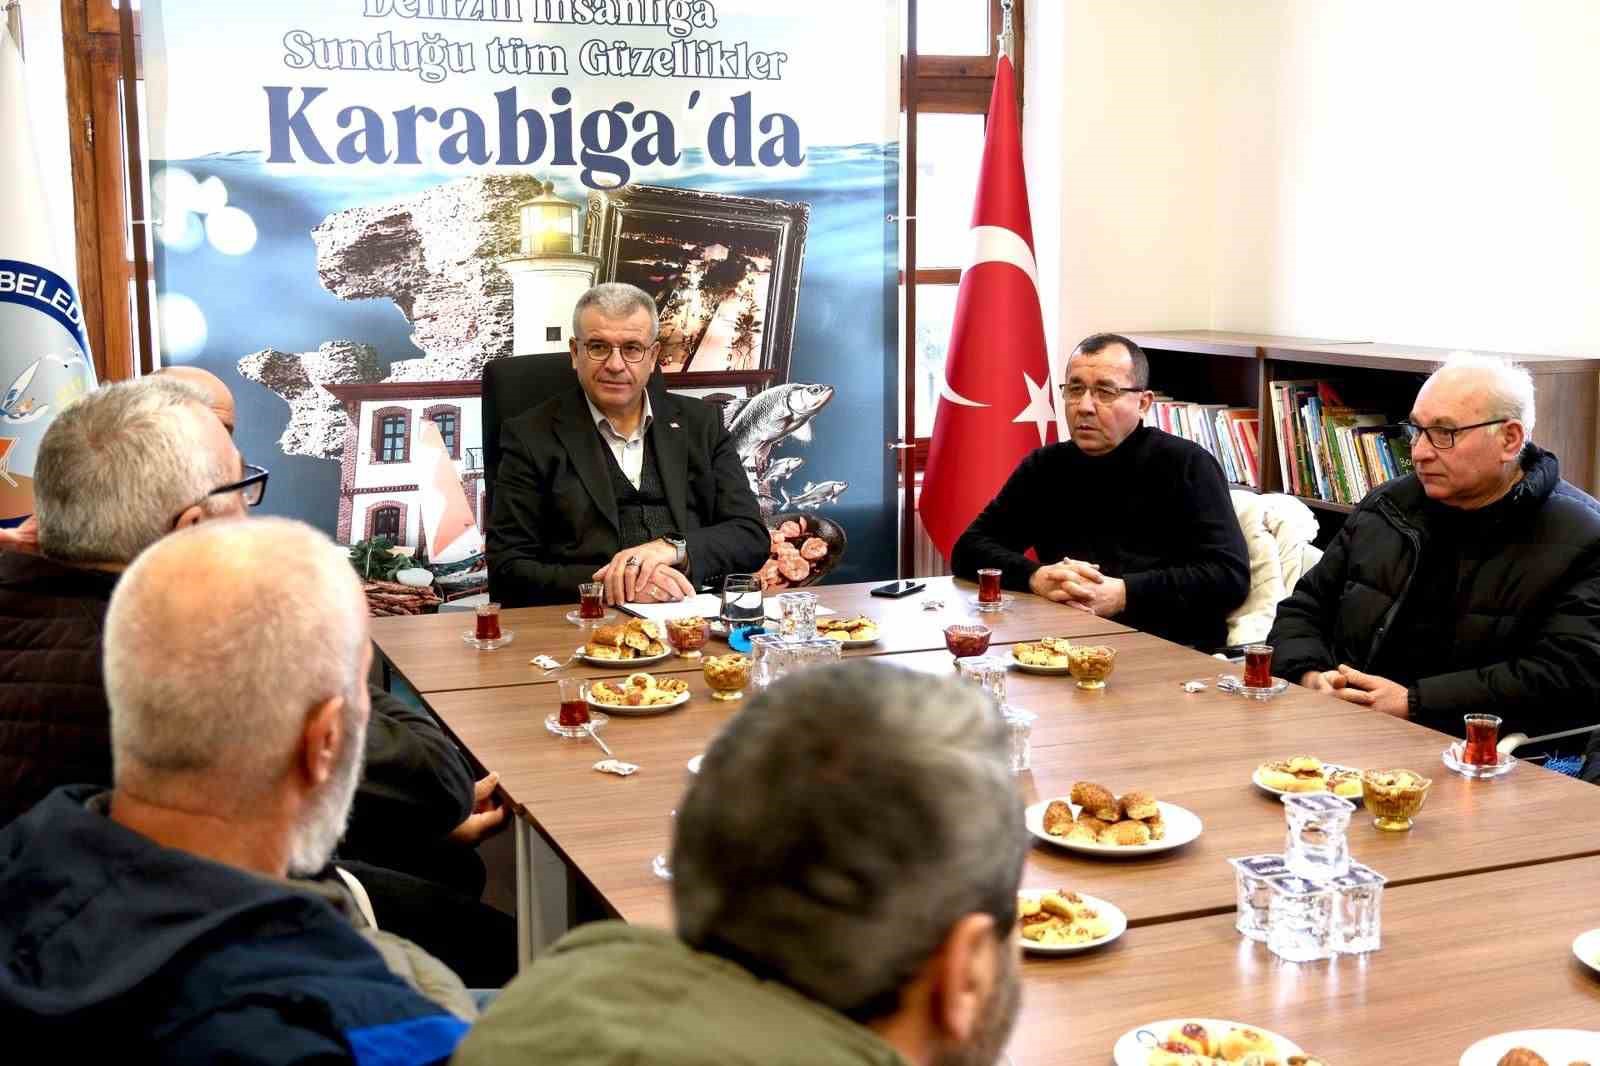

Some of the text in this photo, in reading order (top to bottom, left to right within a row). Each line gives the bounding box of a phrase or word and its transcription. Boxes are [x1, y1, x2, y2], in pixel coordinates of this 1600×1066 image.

[283, 29, 788, 83] Sunduğu tüm Güzellikler
